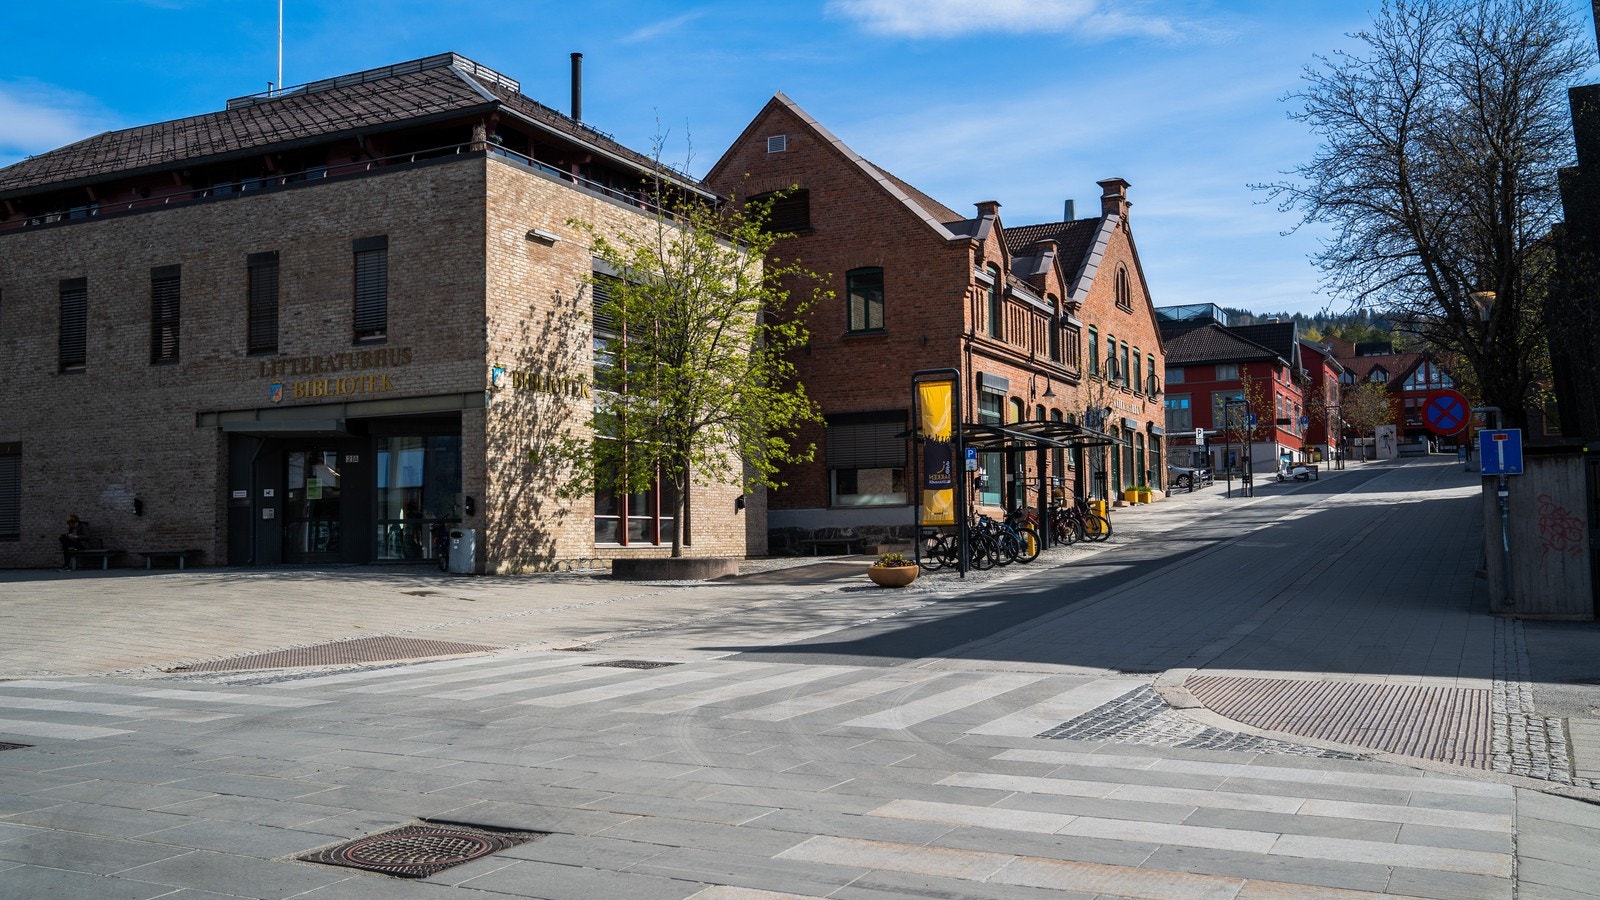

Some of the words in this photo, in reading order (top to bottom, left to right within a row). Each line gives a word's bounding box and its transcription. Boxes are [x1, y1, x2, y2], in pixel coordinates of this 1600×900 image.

[259, 348, 412, 377] LITTERATURHUS
[293, 373, 395, 399] BIBLIOTEK
[512, 371, 591, 398] BIBLIOTEK
[968, 449, 973, 458] P
